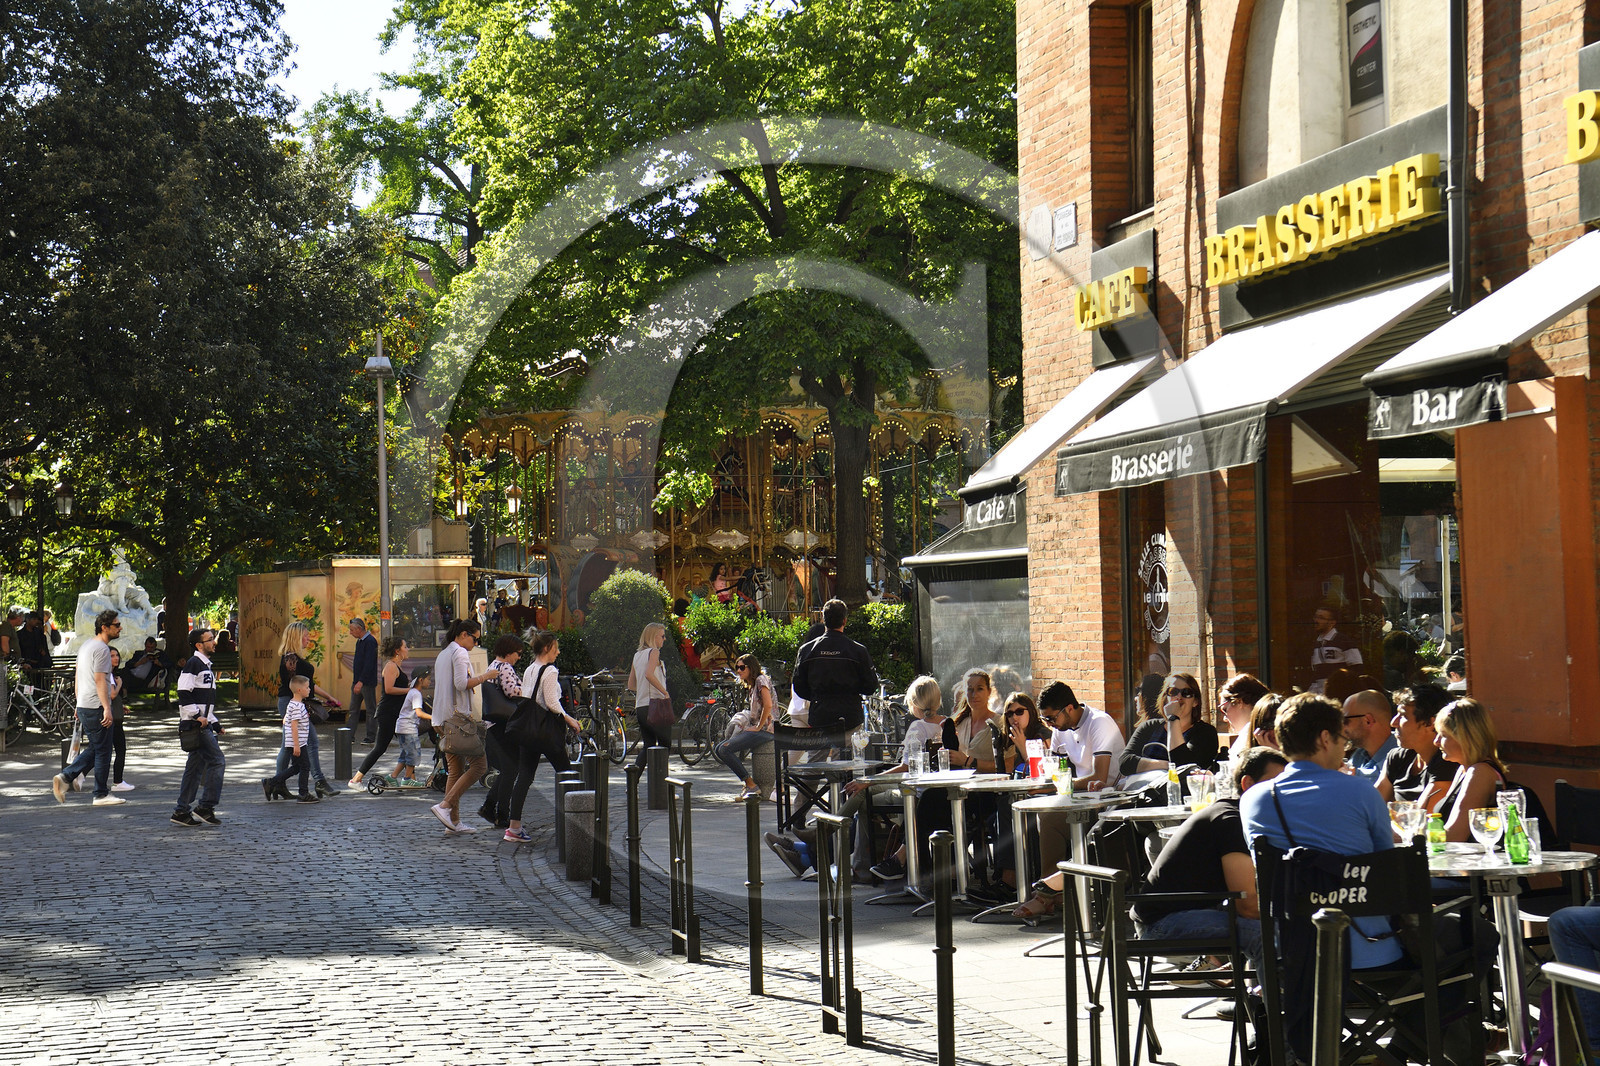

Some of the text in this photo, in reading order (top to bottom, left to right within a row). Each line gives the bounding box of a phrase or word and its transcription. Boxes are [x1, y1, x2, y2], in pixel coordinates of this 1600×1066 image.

[1204, 153, 1432, 288] BRASSERIE
[1074, 267, 1142, 331] CAFE
[1412, 388, 1463, 426] Bar
[976, 493, 1005, 524] Café
